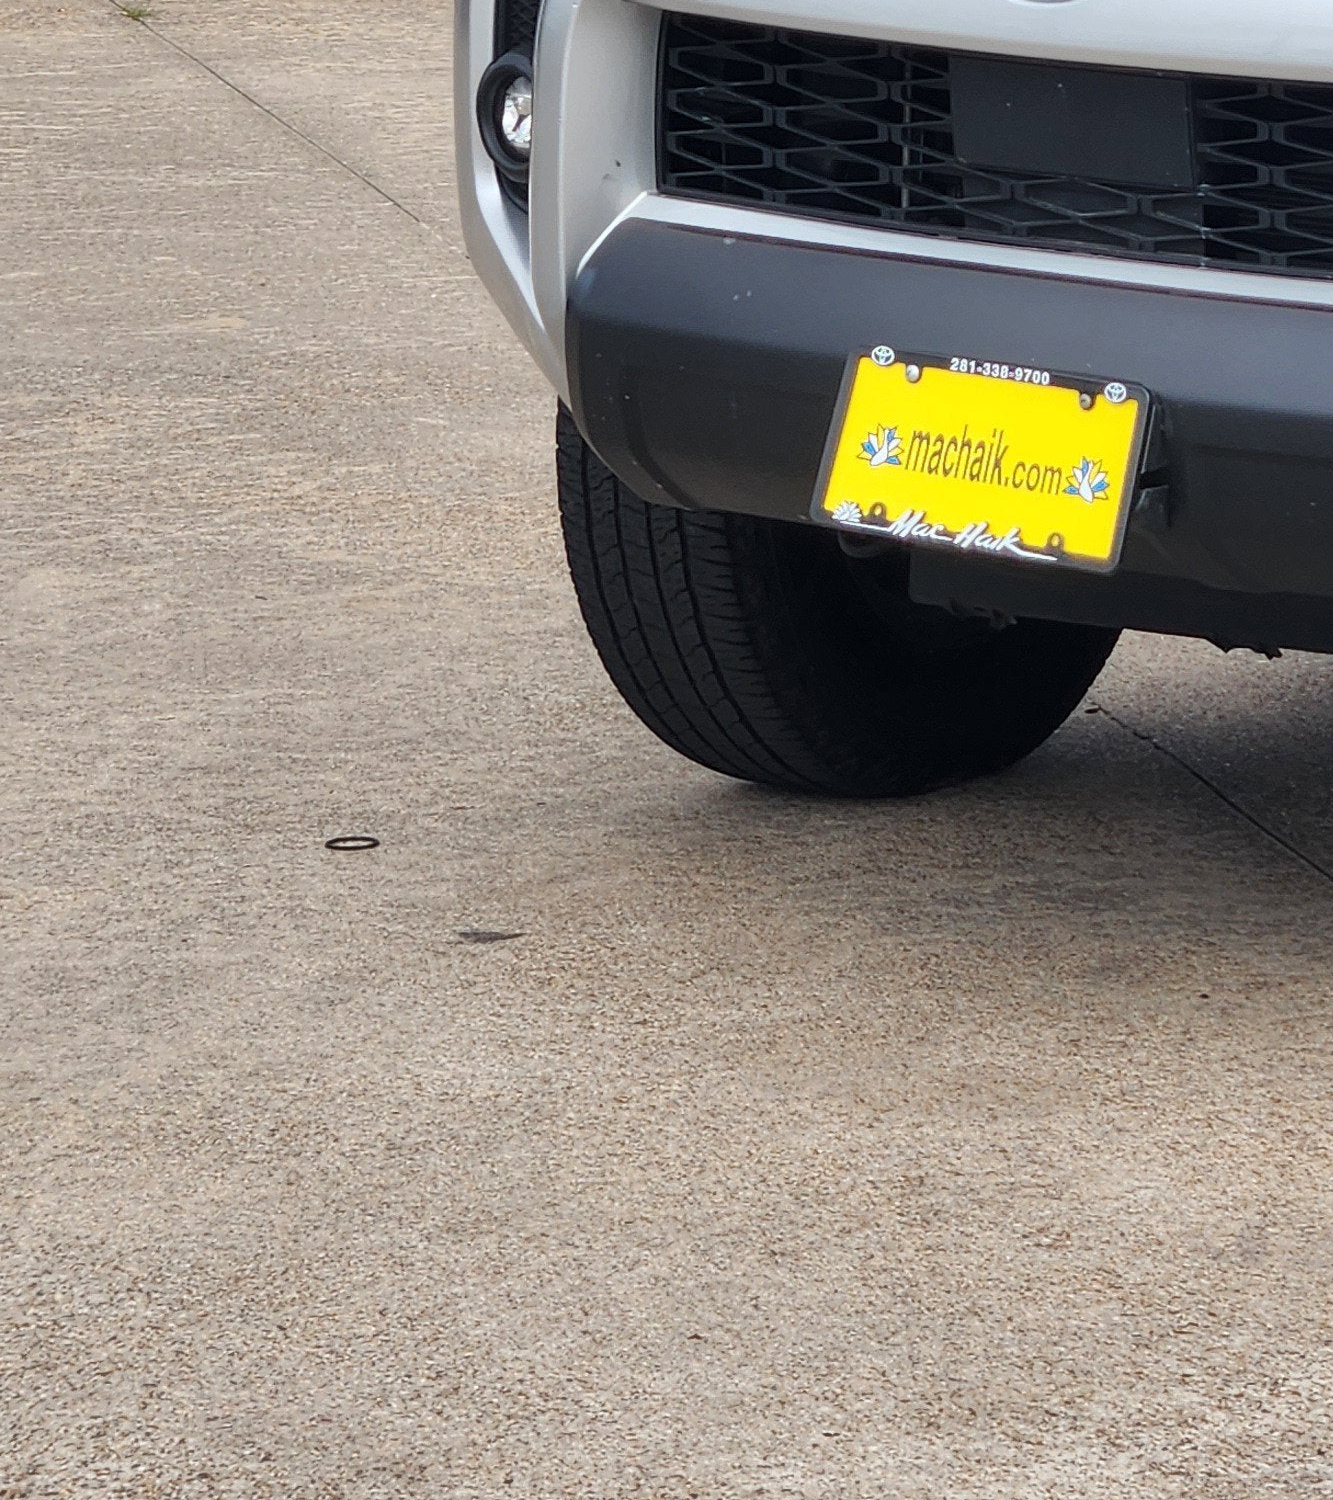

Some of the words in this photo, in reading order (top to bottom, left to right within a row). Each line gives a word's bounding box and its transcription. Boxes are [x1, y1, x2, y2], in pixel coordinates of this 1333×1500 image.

[949, 357, 1051, 386] 281-338-9700
[905, 425, 1062, 495] machaik.com
[886, 508, 953, 542] Mac
[953, 521, 1058, 561] Haik
